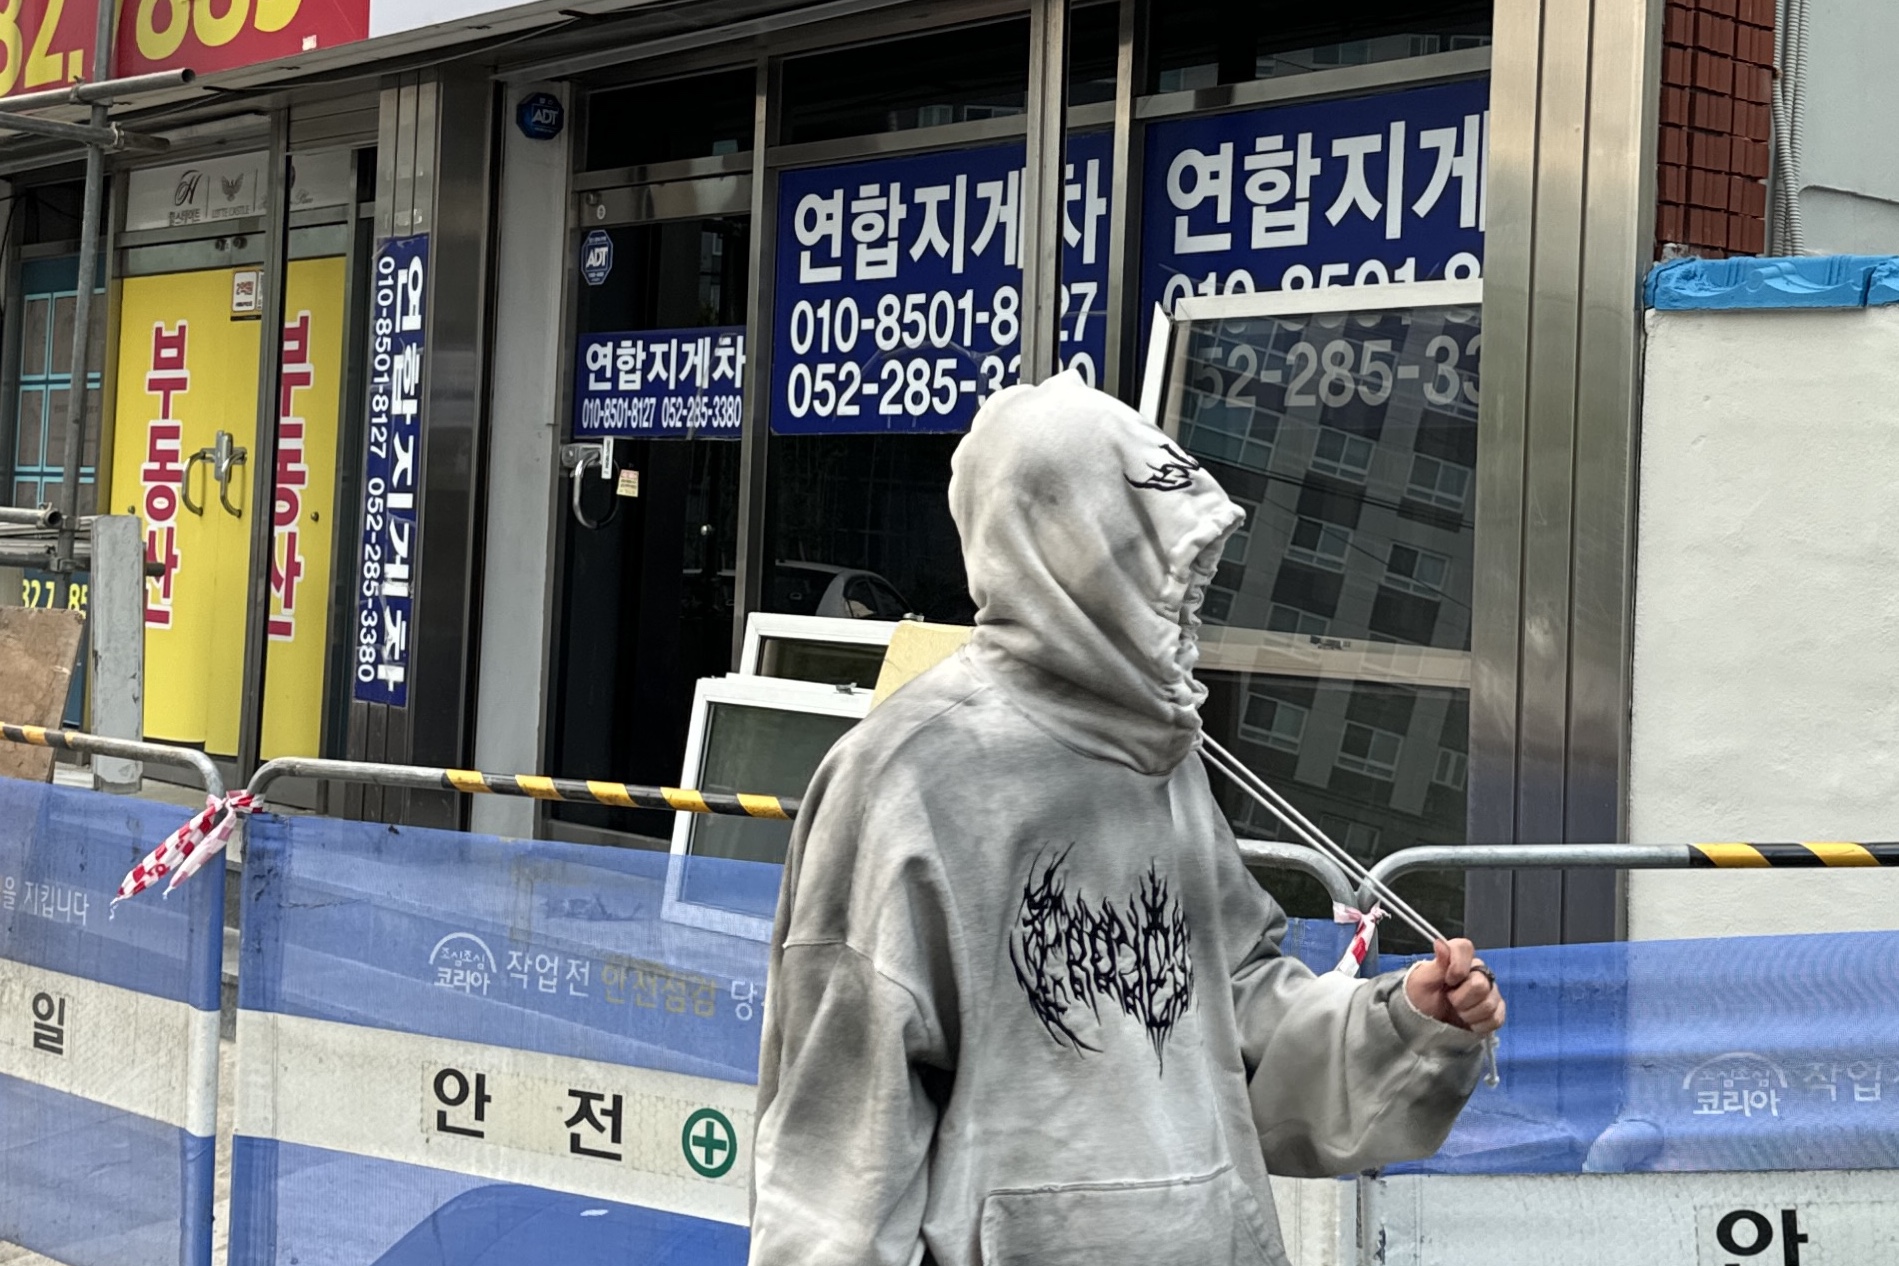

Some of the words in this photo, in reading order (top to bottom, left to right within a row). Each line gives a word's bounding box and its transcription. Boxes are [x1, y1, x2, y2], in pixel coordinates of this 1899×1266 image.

[532, 109, 559, 125] ADT
[794, 159, 1107, 284] 연합지게차
[585, 247, 609, 268] ADT
[370, 256, 395, 459] 010-8501-8127
[586, 335, 747, 391] 연합지게차
[582, 397, 657, 429] 010-8501-8127
[661, 395, 742, 429] 052-285-3380
[378, 256, 423, 692] 연합지게차
[357, 477, 385, 682] 052-285-3380
[24, 881, 90, 926] 지킵니다
[433, 966, 491, 996] 코리아
[440, 946, 486, 971] 조심조심
[506, 950, 559, 994] 작업
[566, 959, 590, 998] 전
[730, 979, 764, 1021] 당
[32, 991, 66, 1056] 일
[433, 1068, 492, 1139] 안
[564, 1088, 623, 1162] 전
[1693, 1088, 1782, 1118] 코리아
